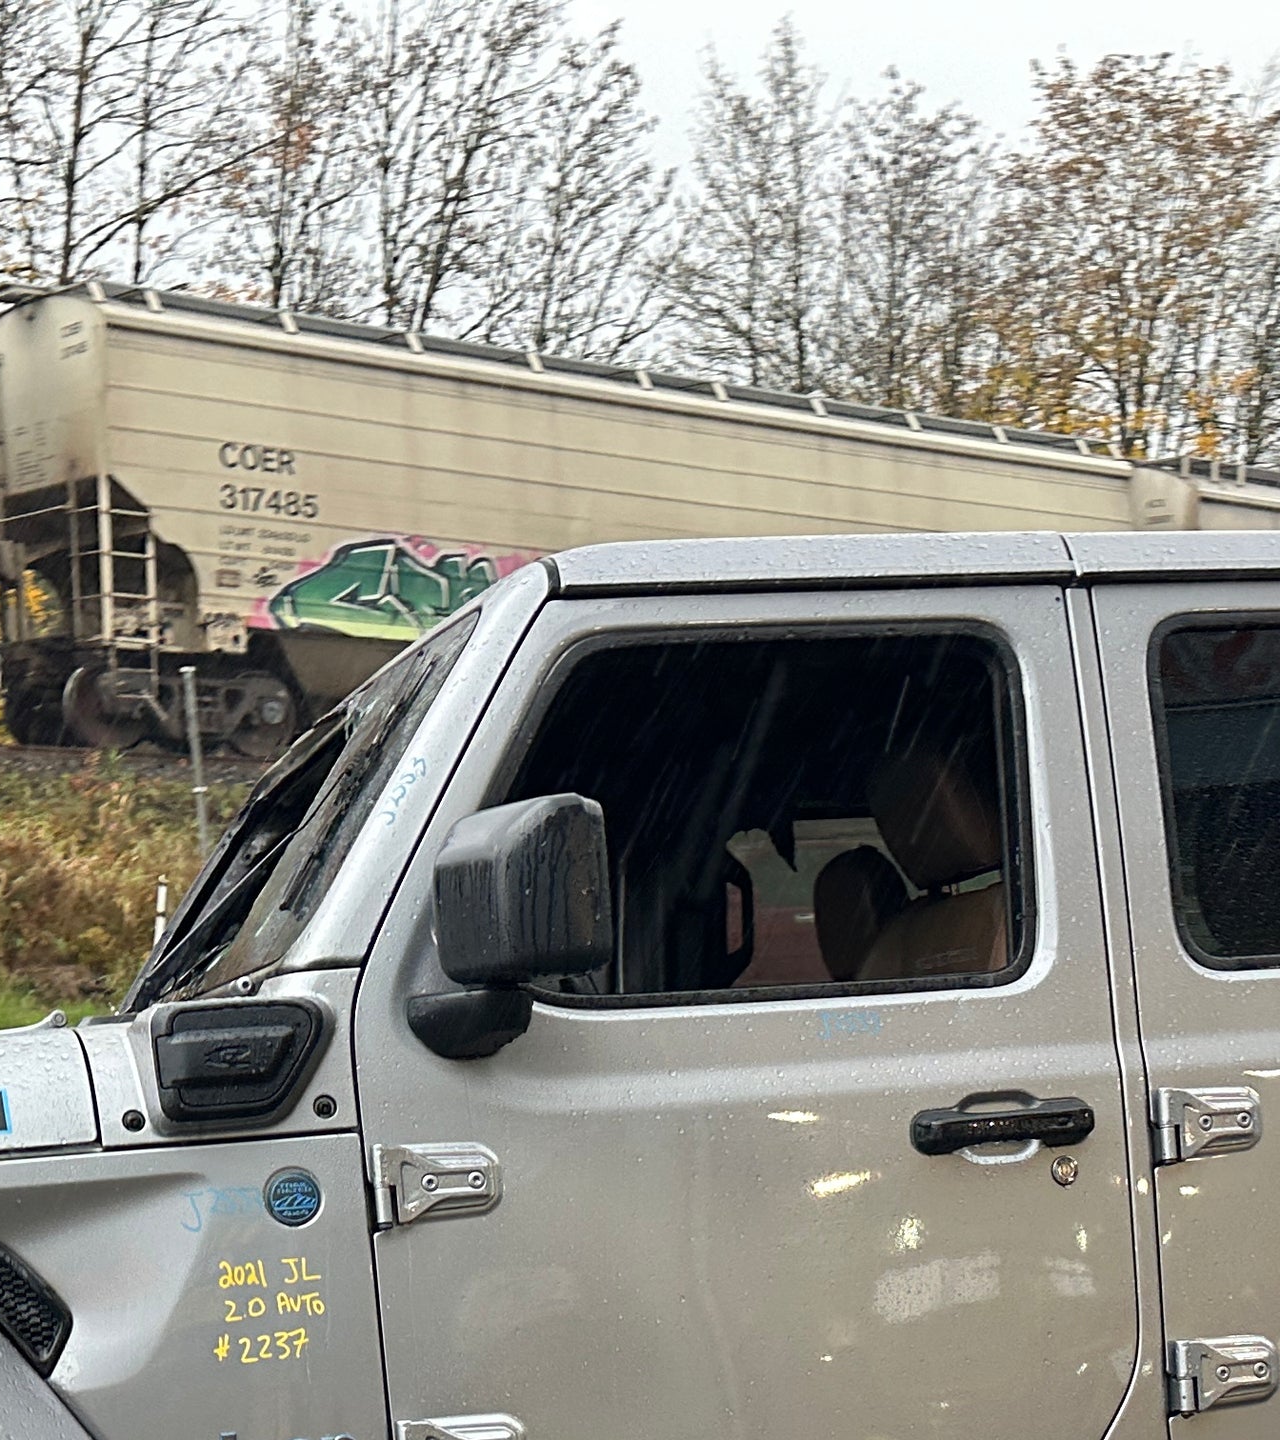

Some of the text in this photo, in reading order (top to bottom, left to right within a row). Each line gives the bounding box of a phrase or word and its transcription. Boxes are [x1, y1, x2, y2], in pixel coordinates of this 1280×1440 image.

[219, 442, 296, 476] COER
[220, 484, 319, 518] 317485
[218, 1257, 321, 1288] 2021 JL
[224, 1296, 266, 1322] 2.0
